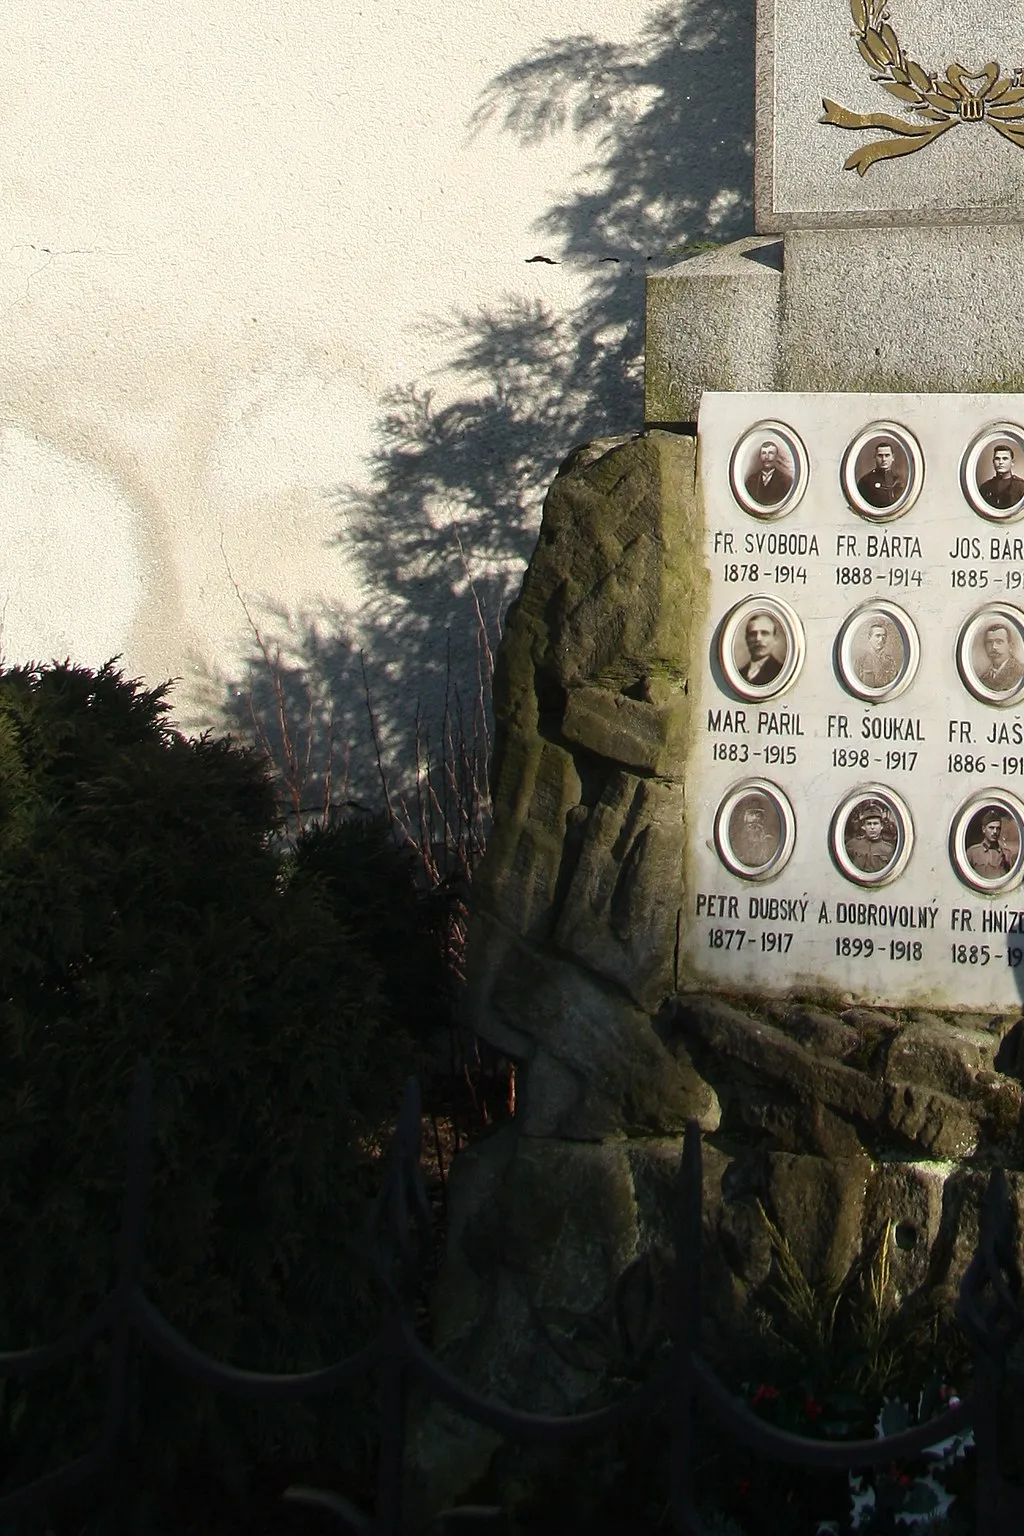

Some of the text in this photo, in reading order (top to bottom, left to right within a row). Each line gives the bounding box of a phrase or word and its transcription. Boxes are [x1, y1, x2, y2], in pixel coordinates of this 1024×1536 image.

[714, 531, 819, 556] FR. SVOBODA
[837, 529, 922, 558] FR. BÁRTA
[950, 537, 984, 560] JOS.
[708, 705, 804, 736] MAR. PAŘIL
[828, 708, 925, 741] FR. ŠOUKAL
[949, 721, 976, 743] FR.
[697, 893, 808, 923] PETR DUBSKÝ
[818, 899, 938, 929] A. DOBROVOLNÝ
[951, 909, 975, 932] FR.
